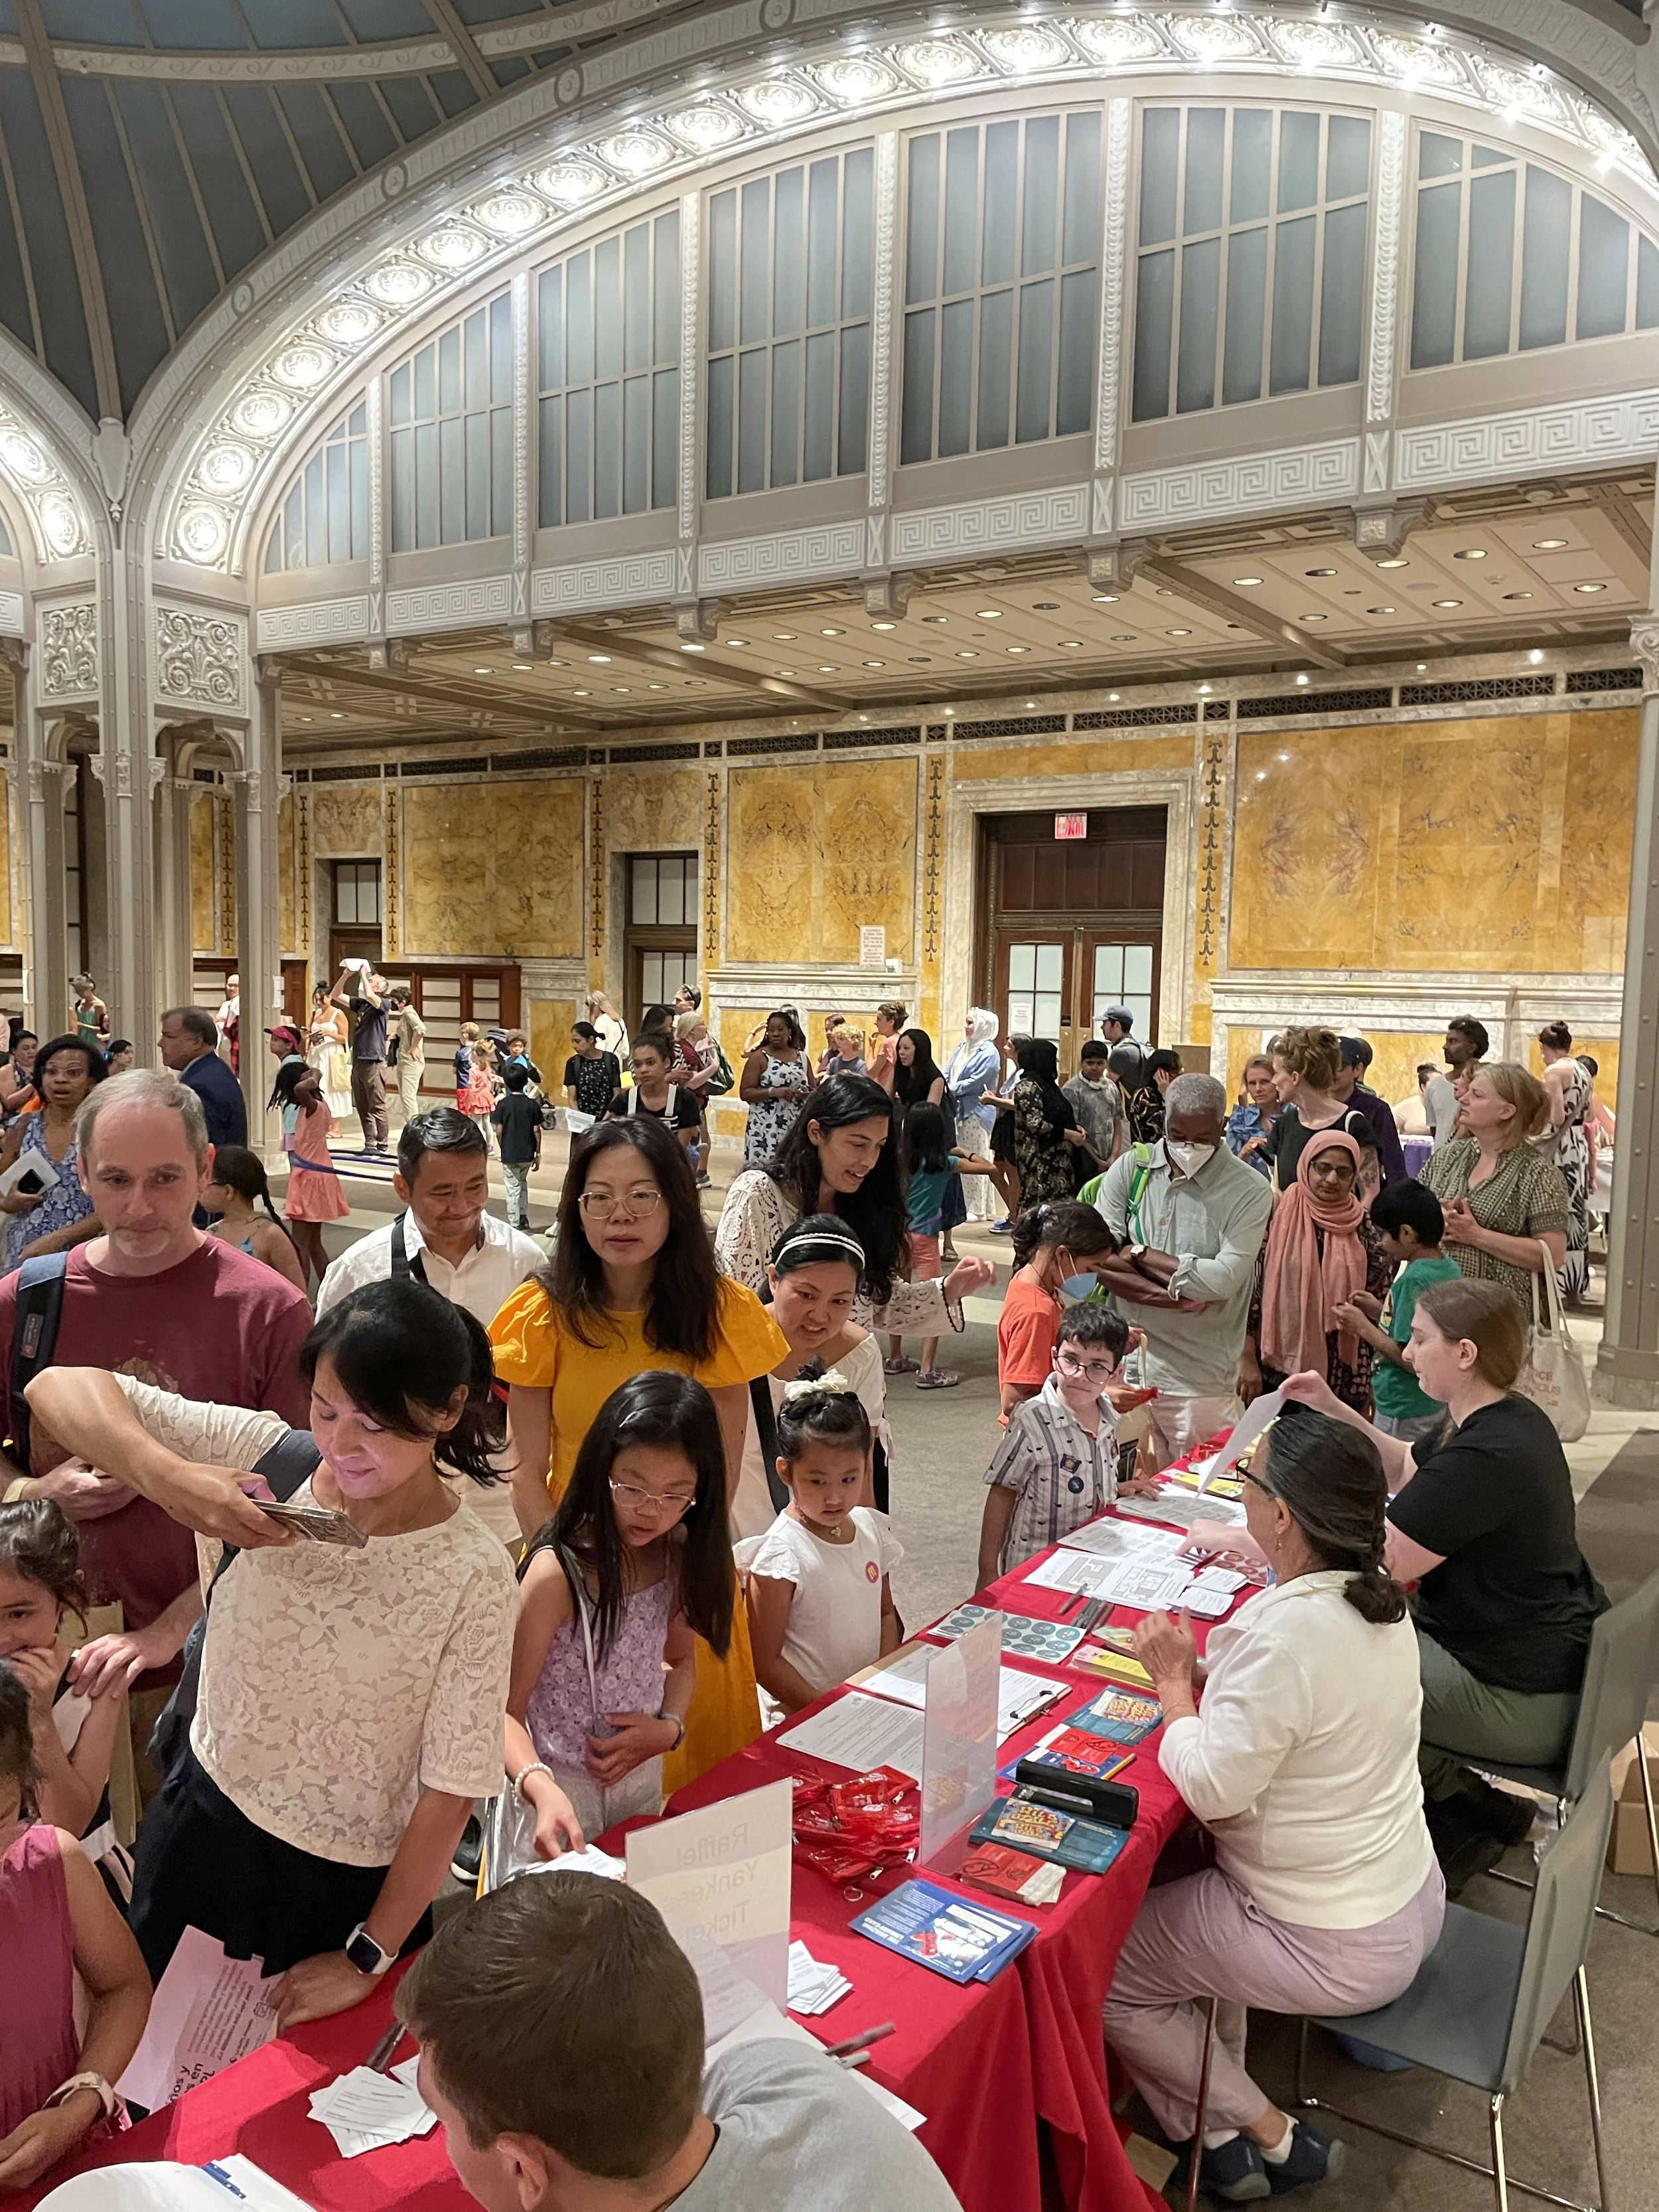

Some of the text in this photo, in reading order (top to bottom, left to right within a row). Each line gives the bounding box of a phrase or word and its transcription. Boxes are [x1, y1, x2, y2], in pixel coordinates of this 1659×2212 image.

[165, 2077, 184, 2105] ños
[180, 2065, 190, 2077] y
[190, 2063, 204, 2079] en
